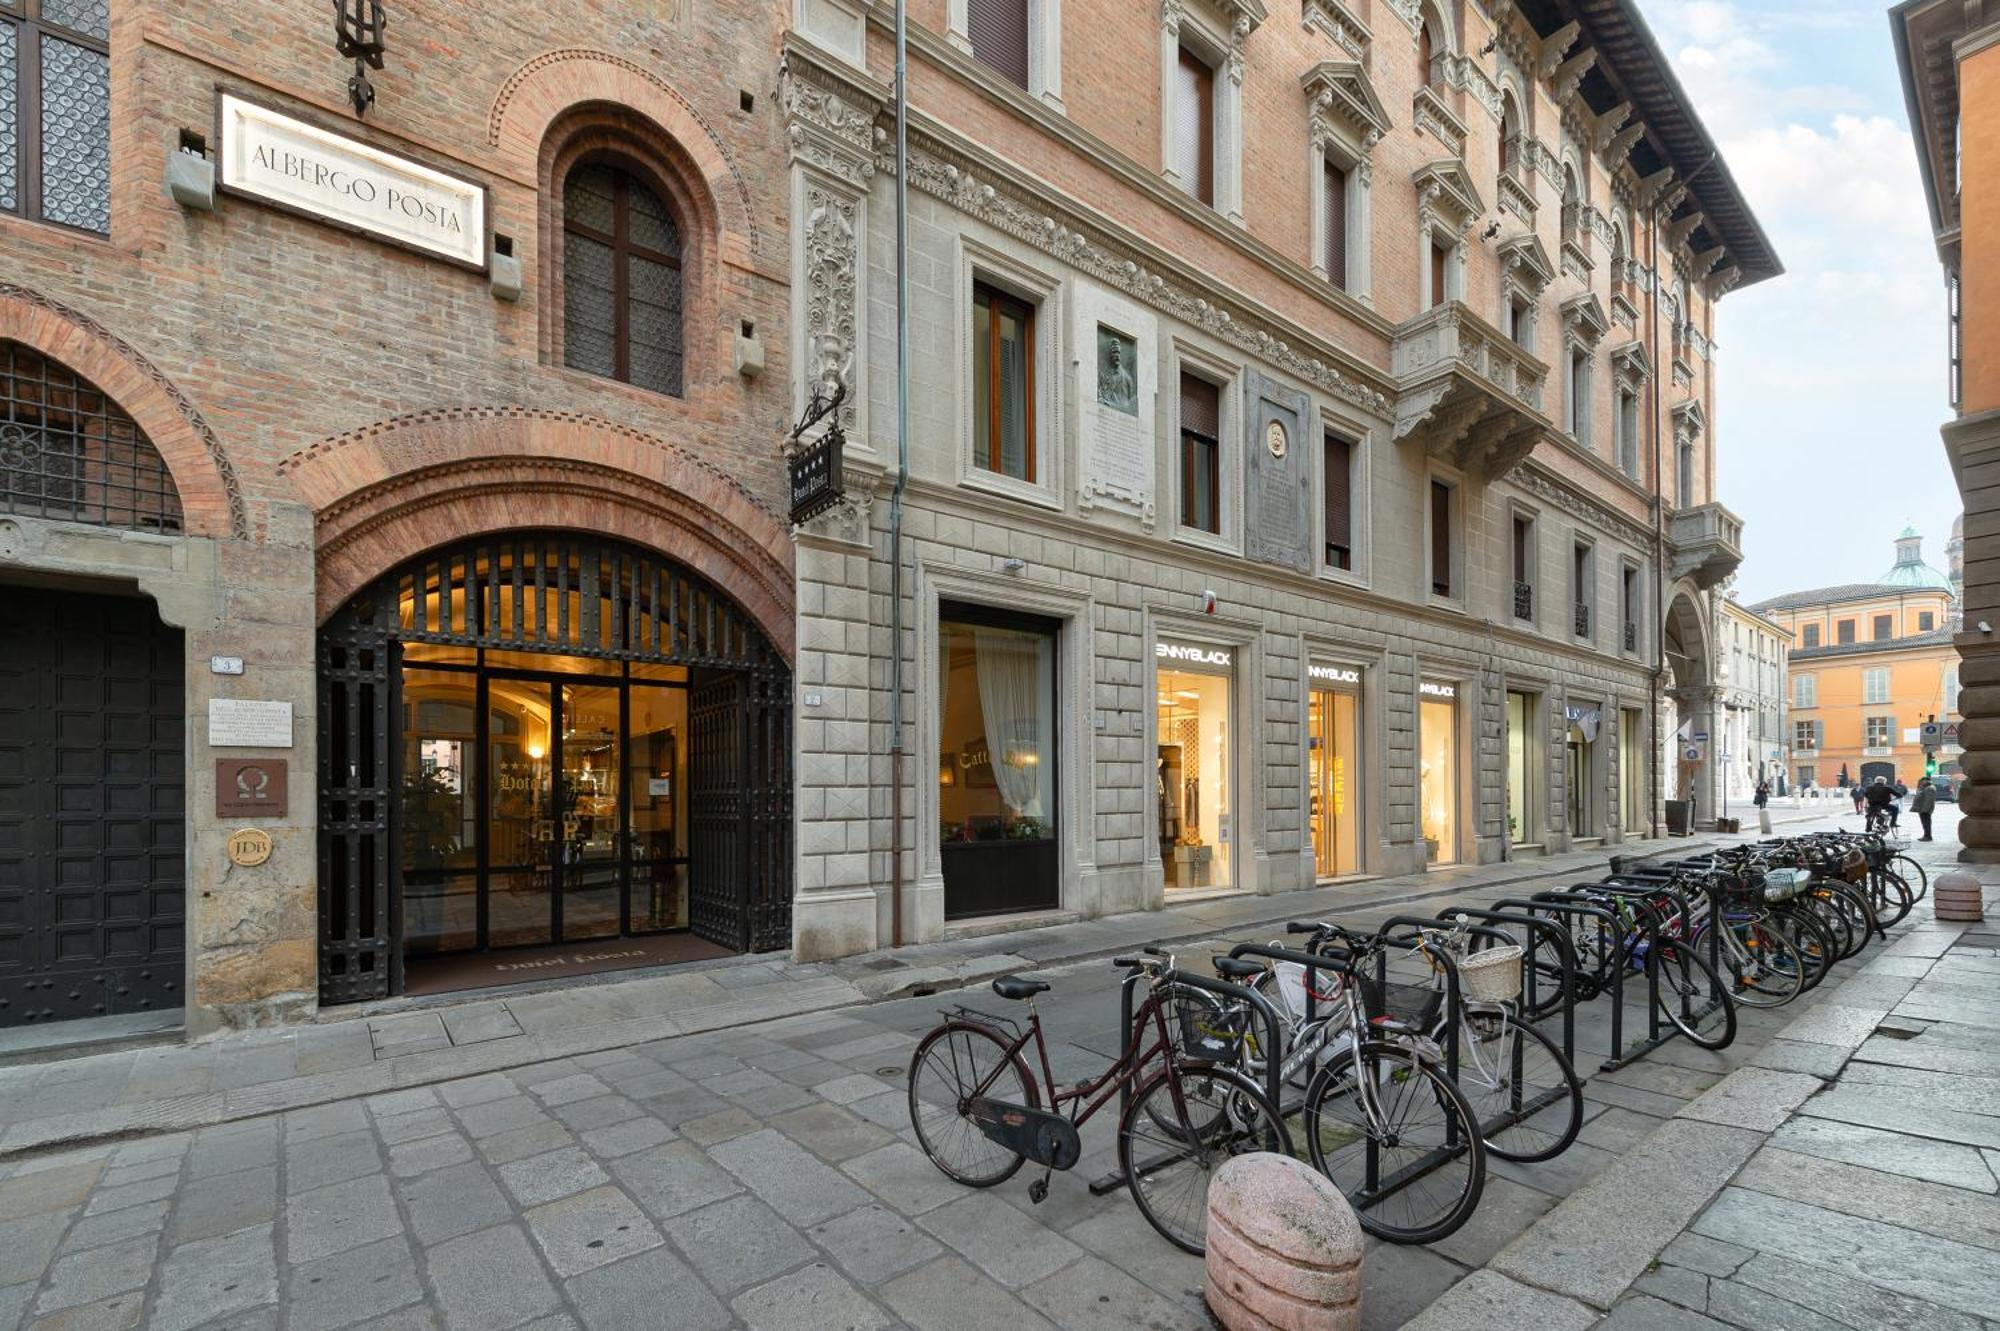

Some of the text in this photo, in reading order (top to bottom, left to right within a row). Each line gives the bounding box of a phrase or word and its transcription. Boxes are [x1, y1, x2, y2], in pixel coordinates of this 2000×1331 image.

[251, 144, 461, 233] ALBERGO POSTA
[235, 841, 267, 857] JDB
